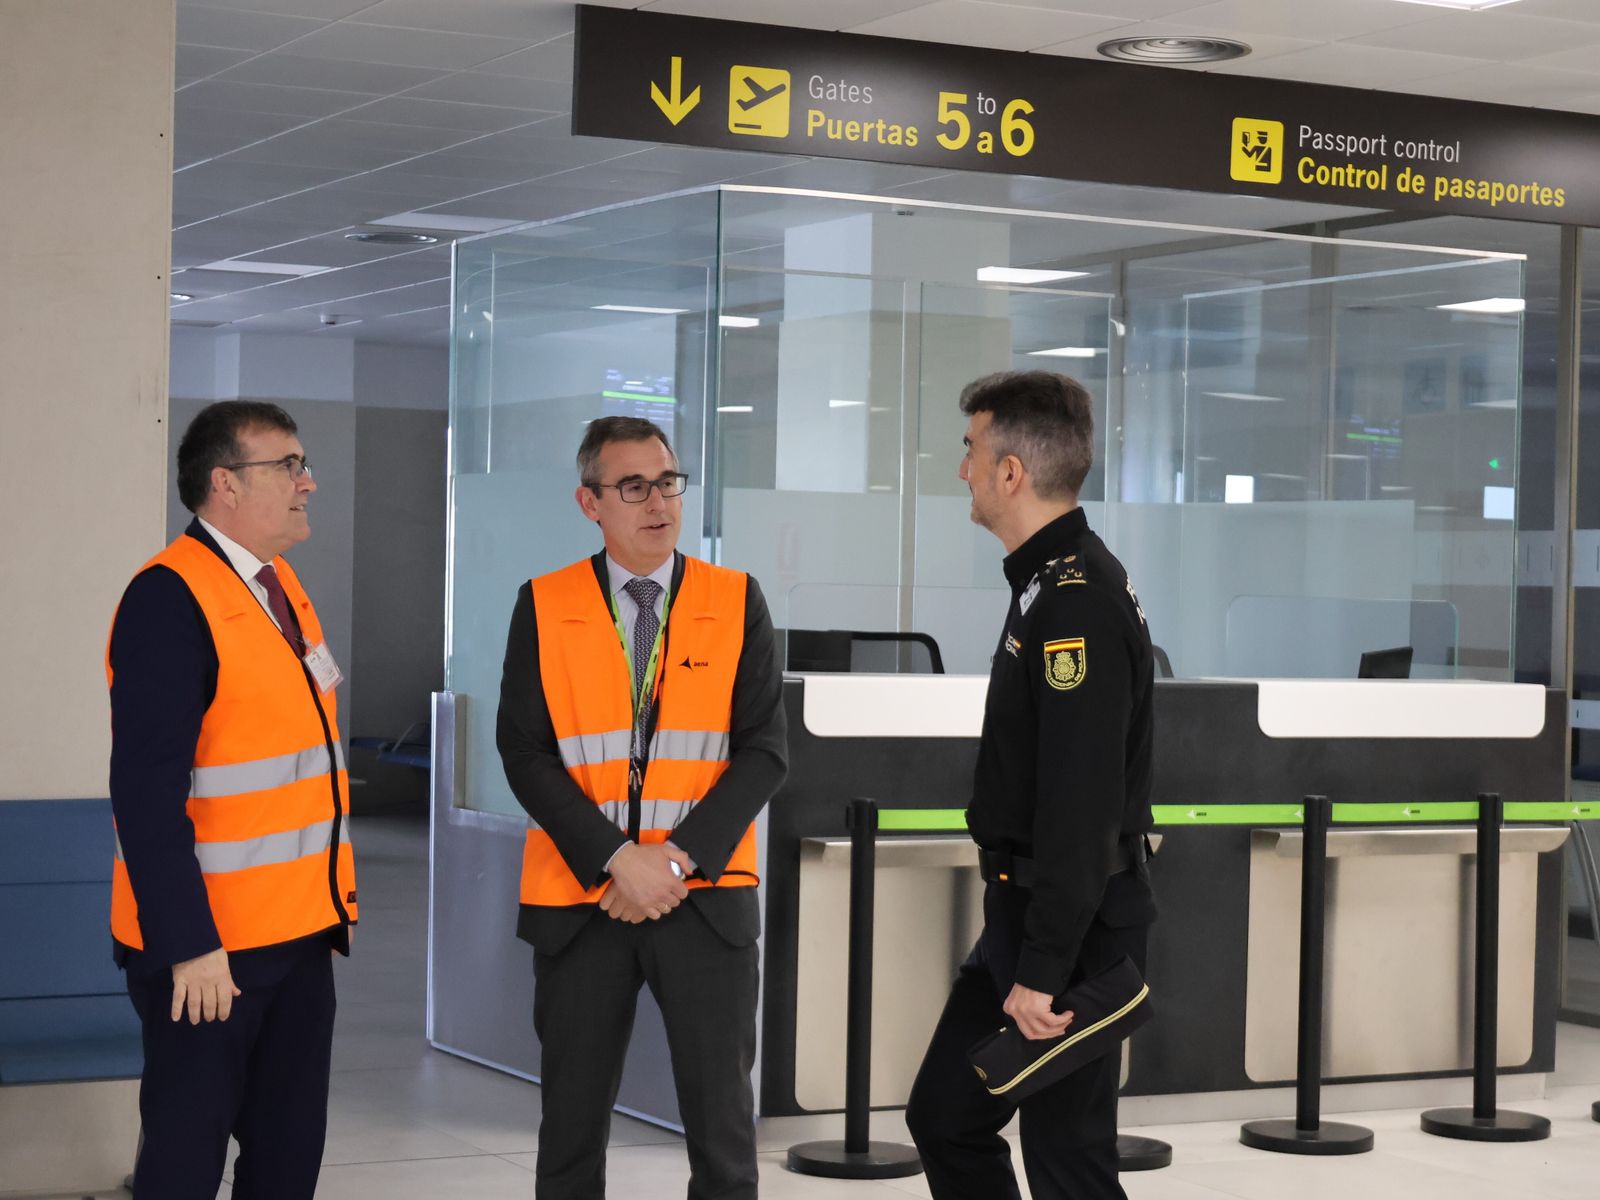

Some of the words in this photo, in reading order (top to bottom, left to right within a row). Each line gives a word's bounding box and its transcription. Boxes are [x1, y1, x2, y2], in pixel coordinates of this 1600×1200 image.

[808, 75, 873, 104] Gates
[976, 92, 997, 115] to
[807, 109, 919, 147] Puertas
[936, 91, 971, 150] 5
[1000, 99, 1035, 157] 6
[976, 130, 994, 154] a
[1299, 125, 1387, 157] Passport
[1394, 140, 1460, 163] control
[1297, 157, 1388, 191] Control
[1396, 167, 1426, 194] de
[1434, 176, 1566, 208] pasaportes
